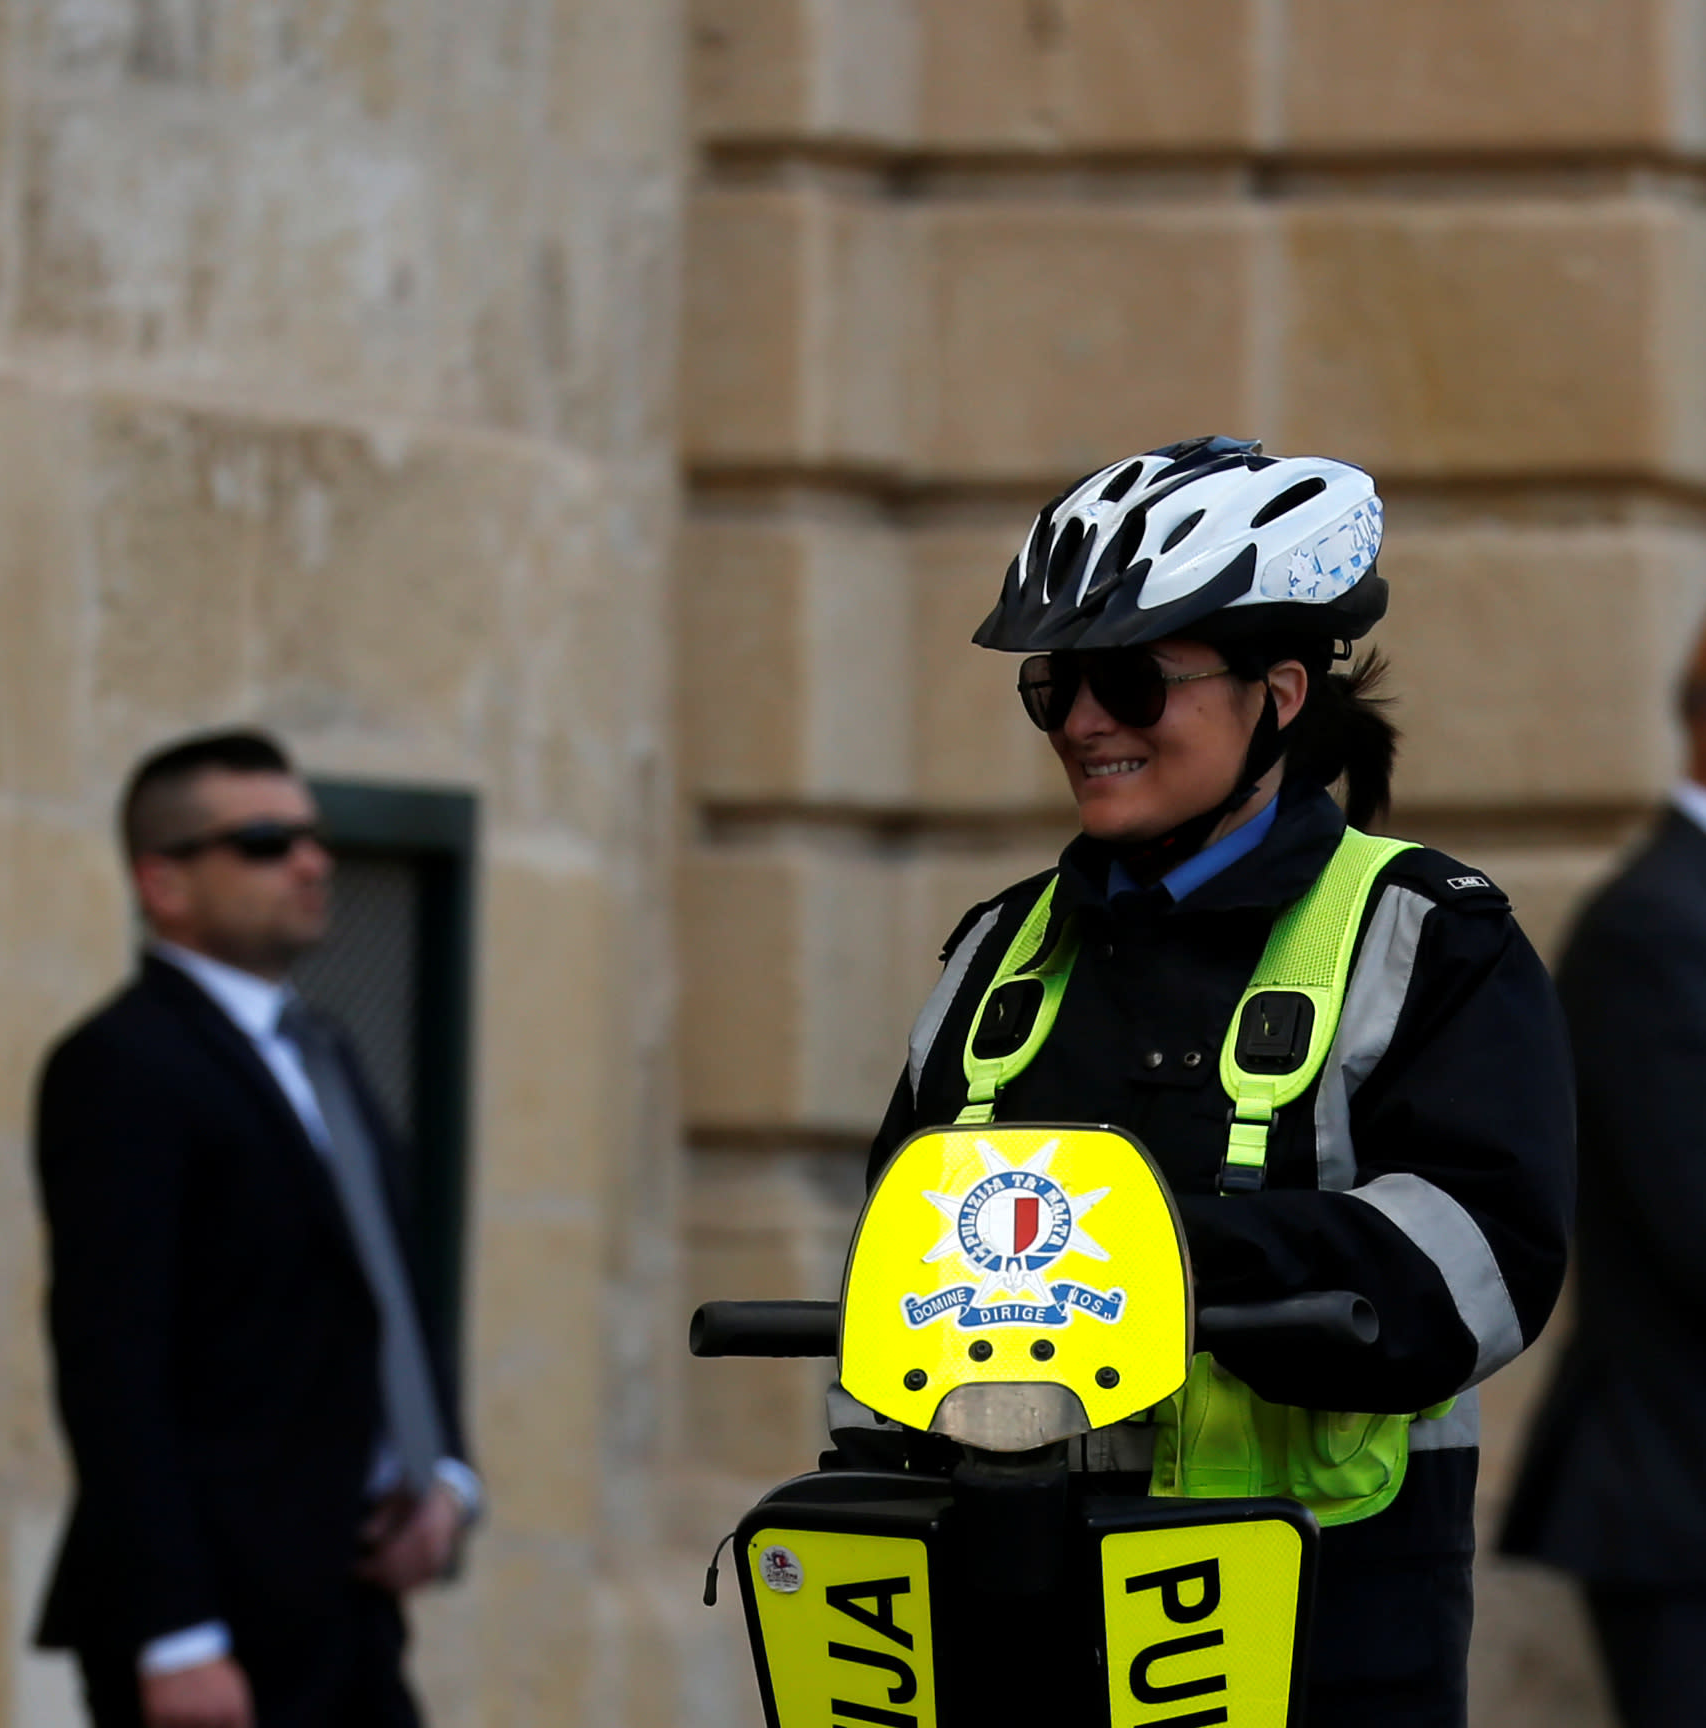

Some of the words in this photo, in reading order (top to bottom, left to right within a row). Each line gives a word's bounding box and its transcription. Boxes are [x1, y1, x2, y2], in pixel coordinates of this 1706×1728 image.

[959, 1176, 1006, 1248] PULIZIJA
[912, 1288, 968, 1323] DOMINE
[979, 1305, 1046, 1323] DIRIGE
